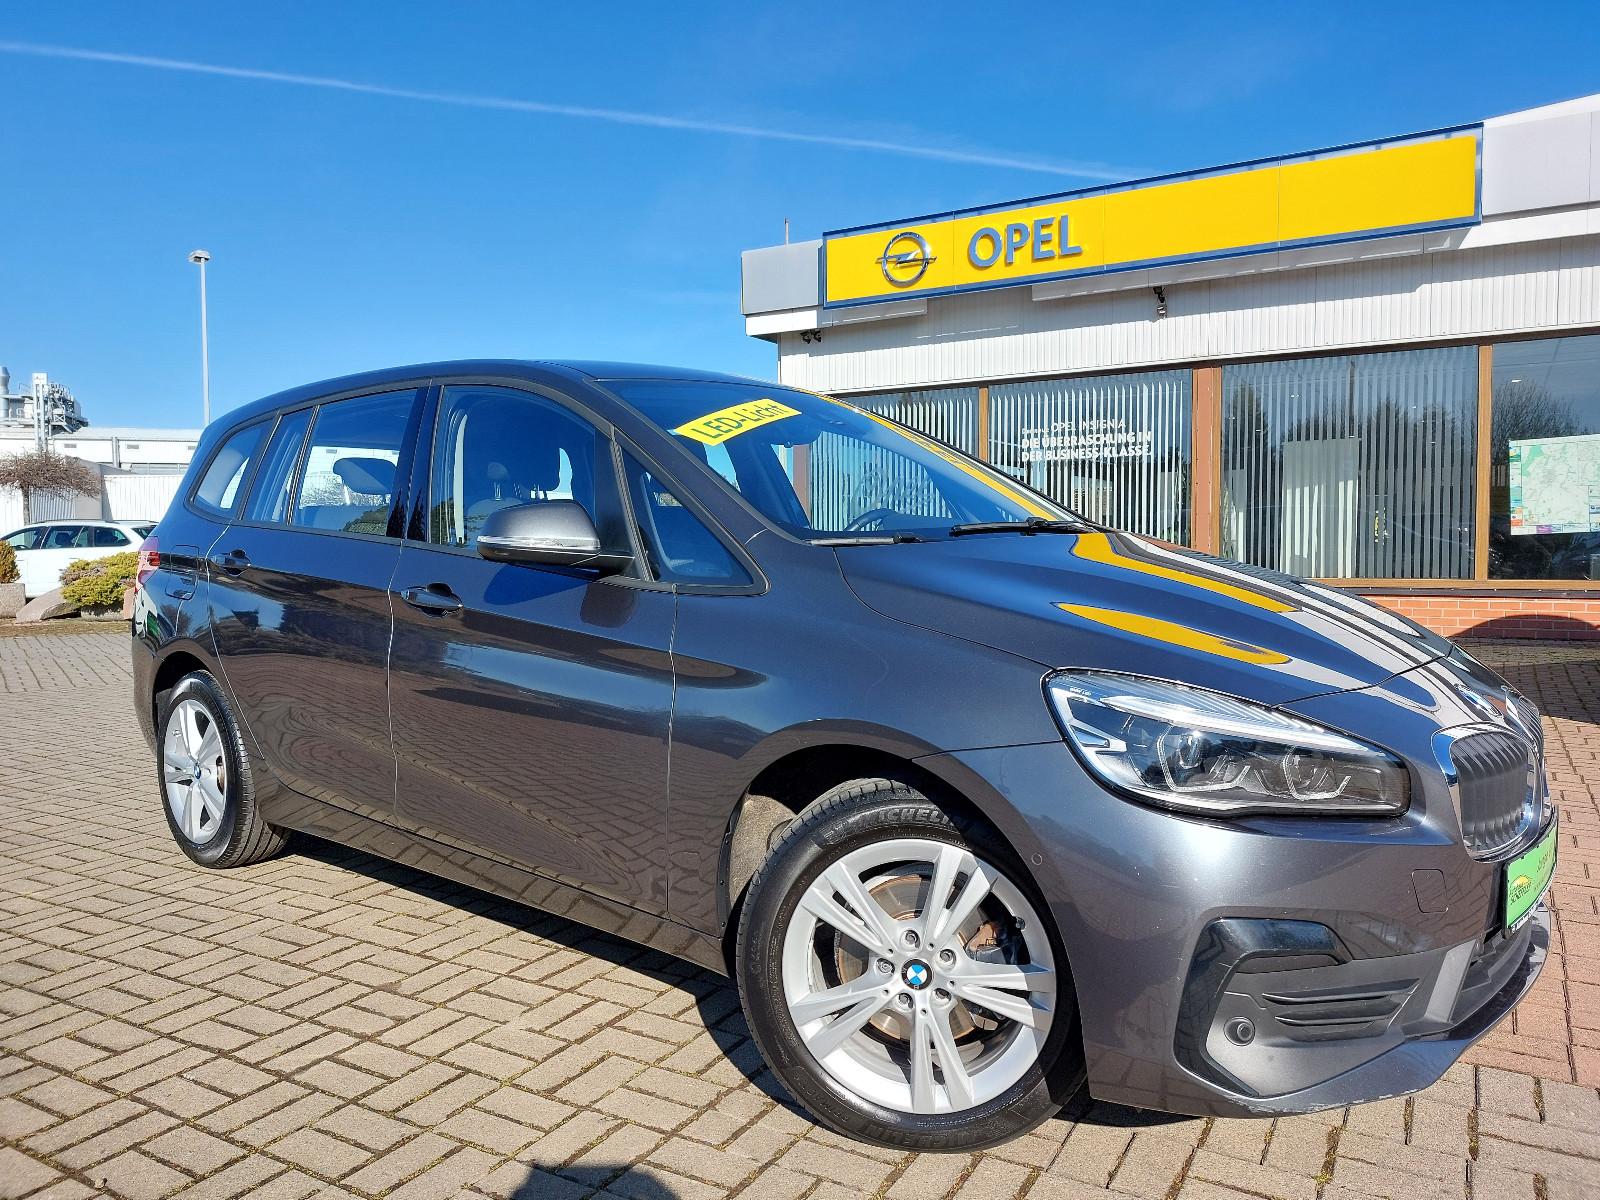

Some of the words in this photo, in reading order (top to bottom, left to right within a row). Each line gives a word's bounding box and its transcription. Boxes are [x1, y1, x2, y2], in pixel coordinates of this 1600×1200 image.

[968, 215, 1082, 268] OPEL
[690, 403, 790, 439] LED-Licht
[1079, 418, 1126, 430] NSIGNA
